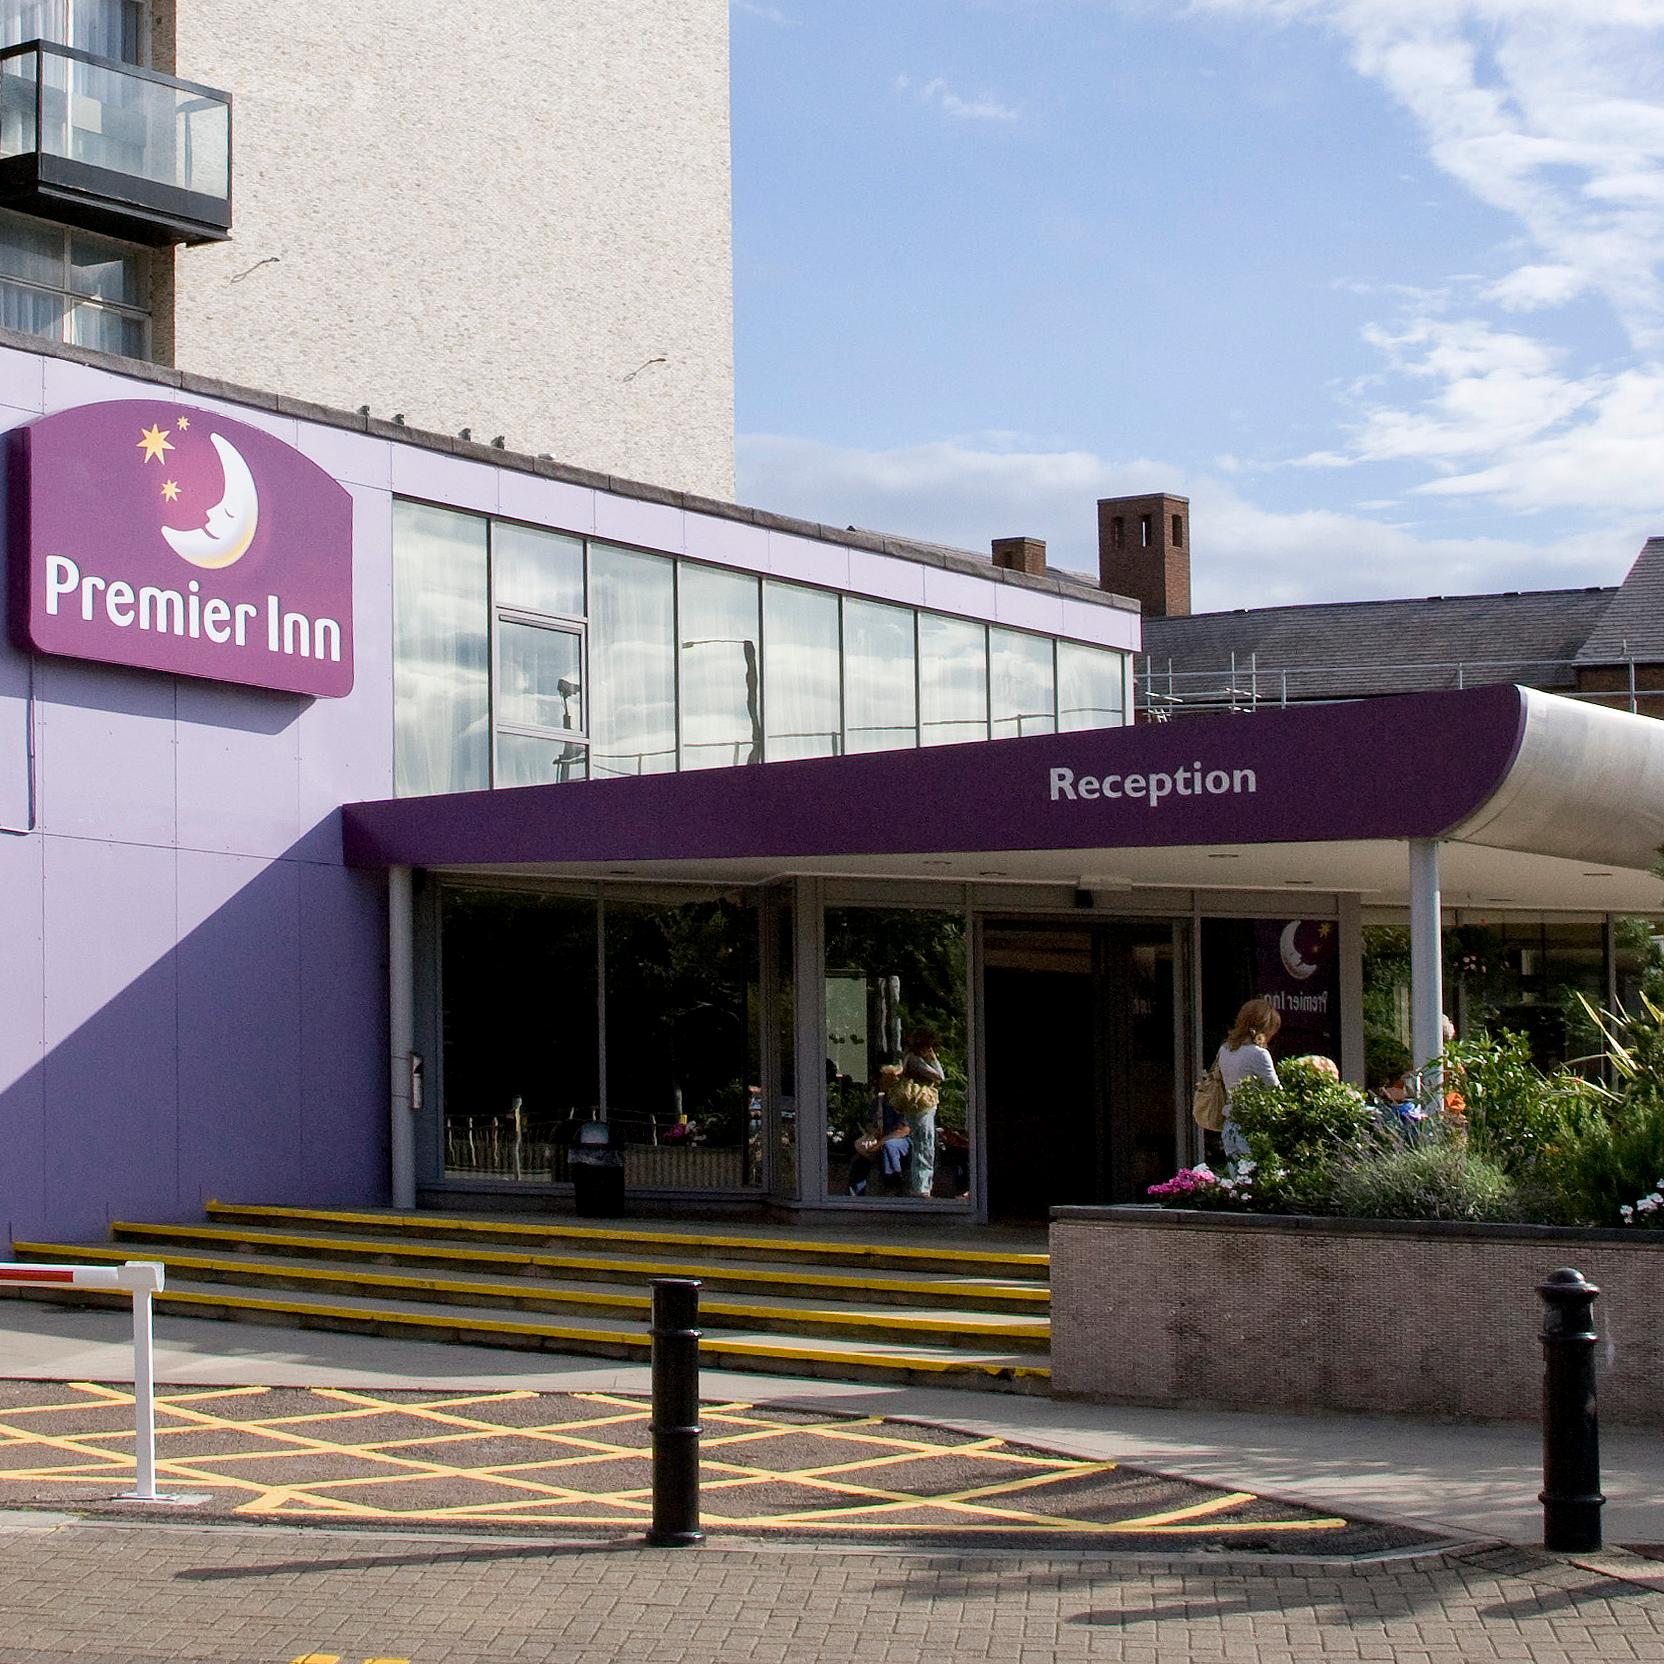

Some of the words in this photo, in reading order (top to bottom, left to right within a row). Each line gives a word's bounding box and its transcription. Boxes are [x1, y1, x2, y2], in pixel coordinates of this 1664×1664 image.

[45, 554, 258, 647] Premier
[267, 594, 341, 662] Inn
[1049, 760, 1257, 808] Reception
